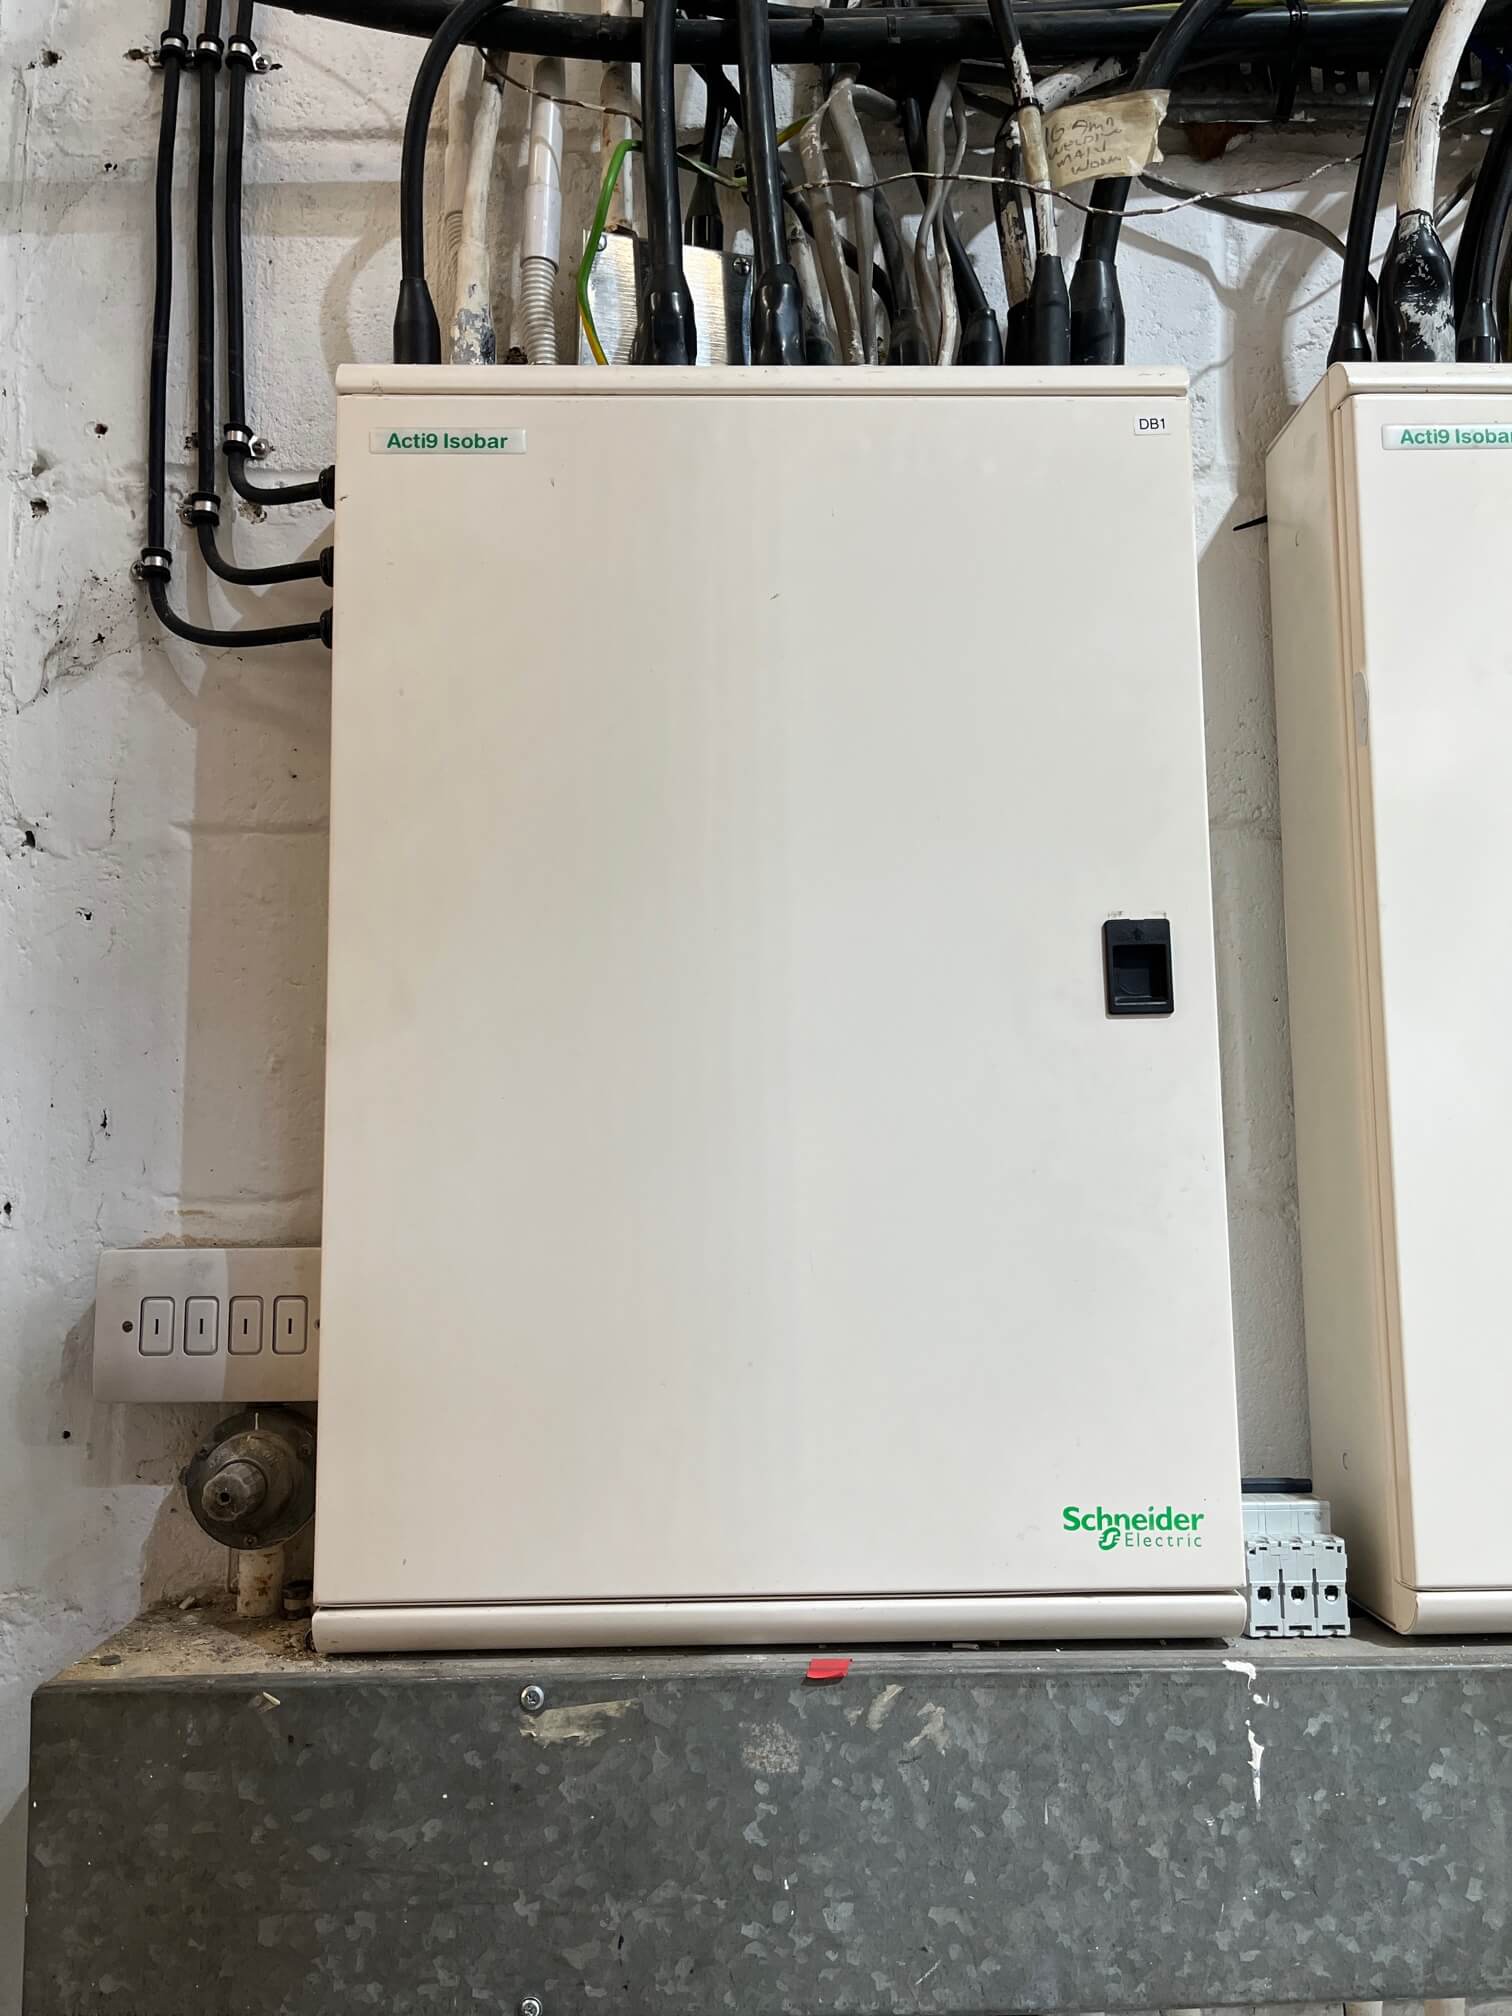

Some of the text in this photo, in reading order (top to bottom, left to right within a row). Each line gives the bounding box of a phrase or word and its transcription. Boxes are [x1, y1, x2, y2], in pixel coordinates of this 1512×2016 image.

[1139, 418, 1166, 430] DB1
[386, 432, 508, 449] Acti9 Isobar
[1400, 428, 1512, 445] Acti9 Isoba
[1062, 1505, 1205, 1532] Schneider
[1124, 1532, 1203, 1548] Electric
